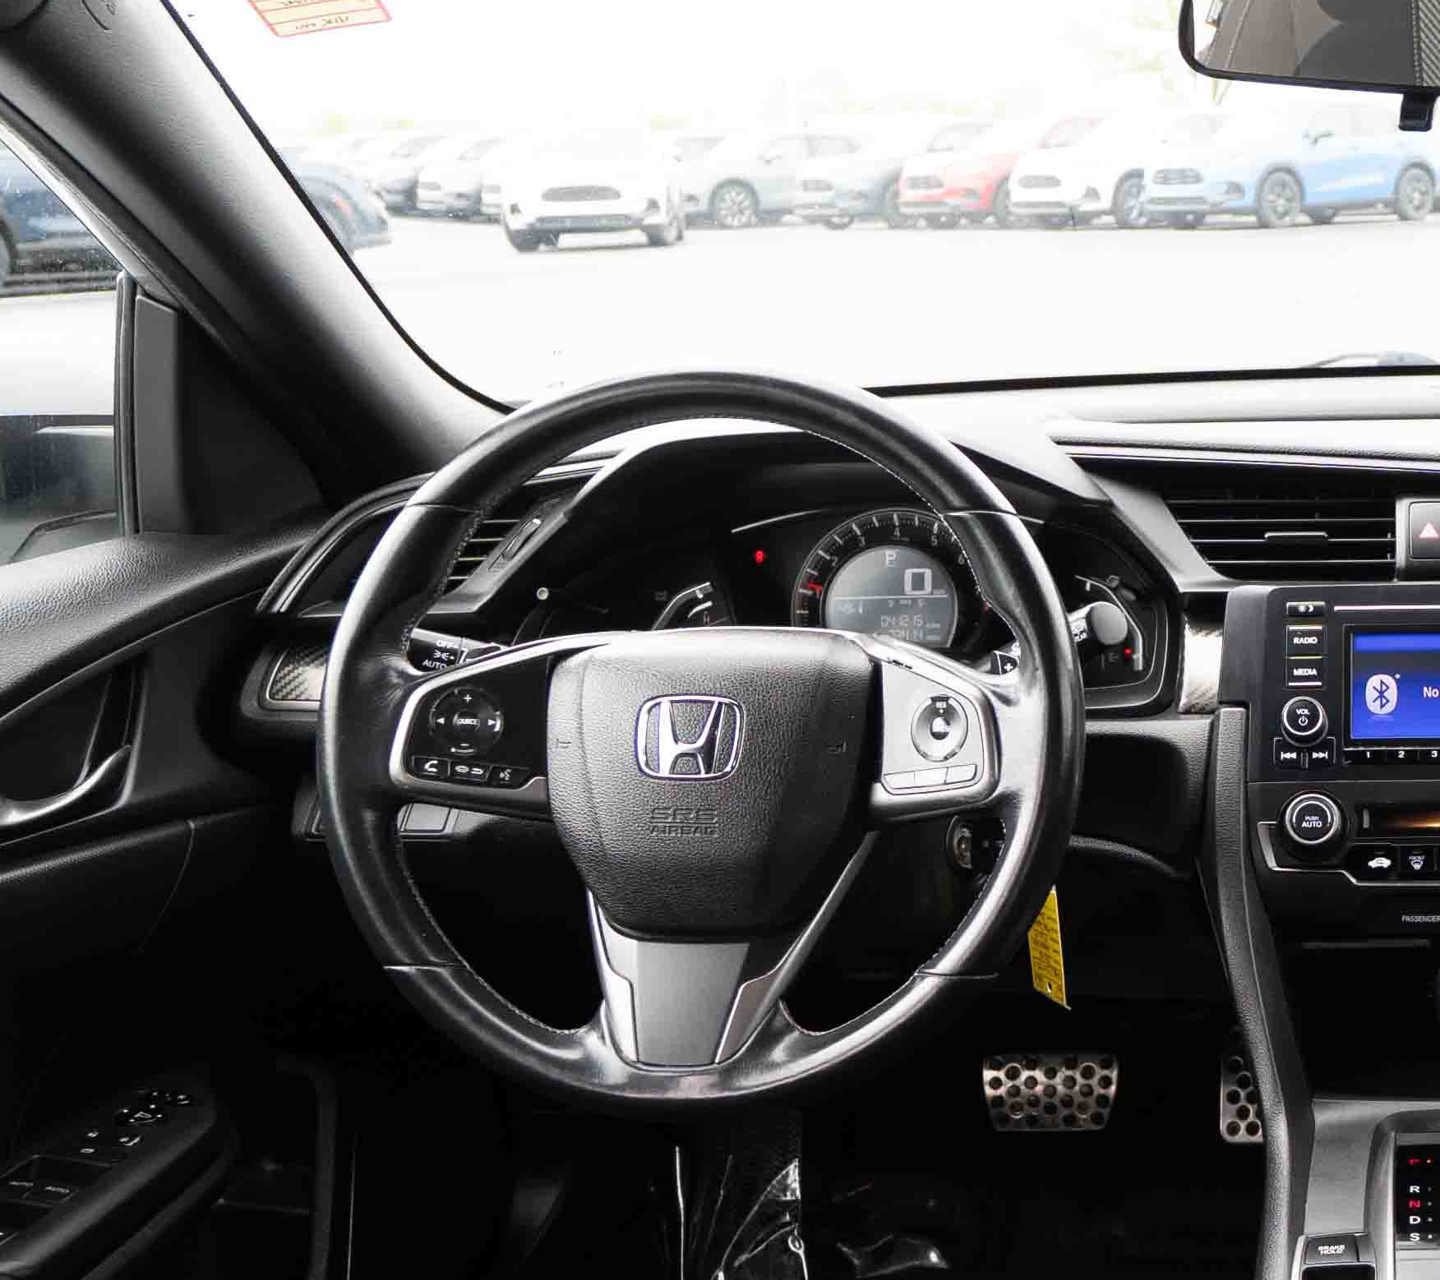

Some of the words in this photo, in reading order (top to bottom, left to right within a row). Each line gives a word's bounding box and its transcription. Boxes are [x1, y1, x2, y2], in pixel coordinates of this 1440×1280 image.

[1293, 636, 1318, 645] RADIO
[1293, 668, 1318, 677] MEDIA
[1423, 686, 1439, 698] No
[650, 807, 718, 824] SRS
[1409, 1185, 1421, 1193] R
[1409, 1216, 1421, 1224] D
[1409, 1233, 1421, 1241] S
